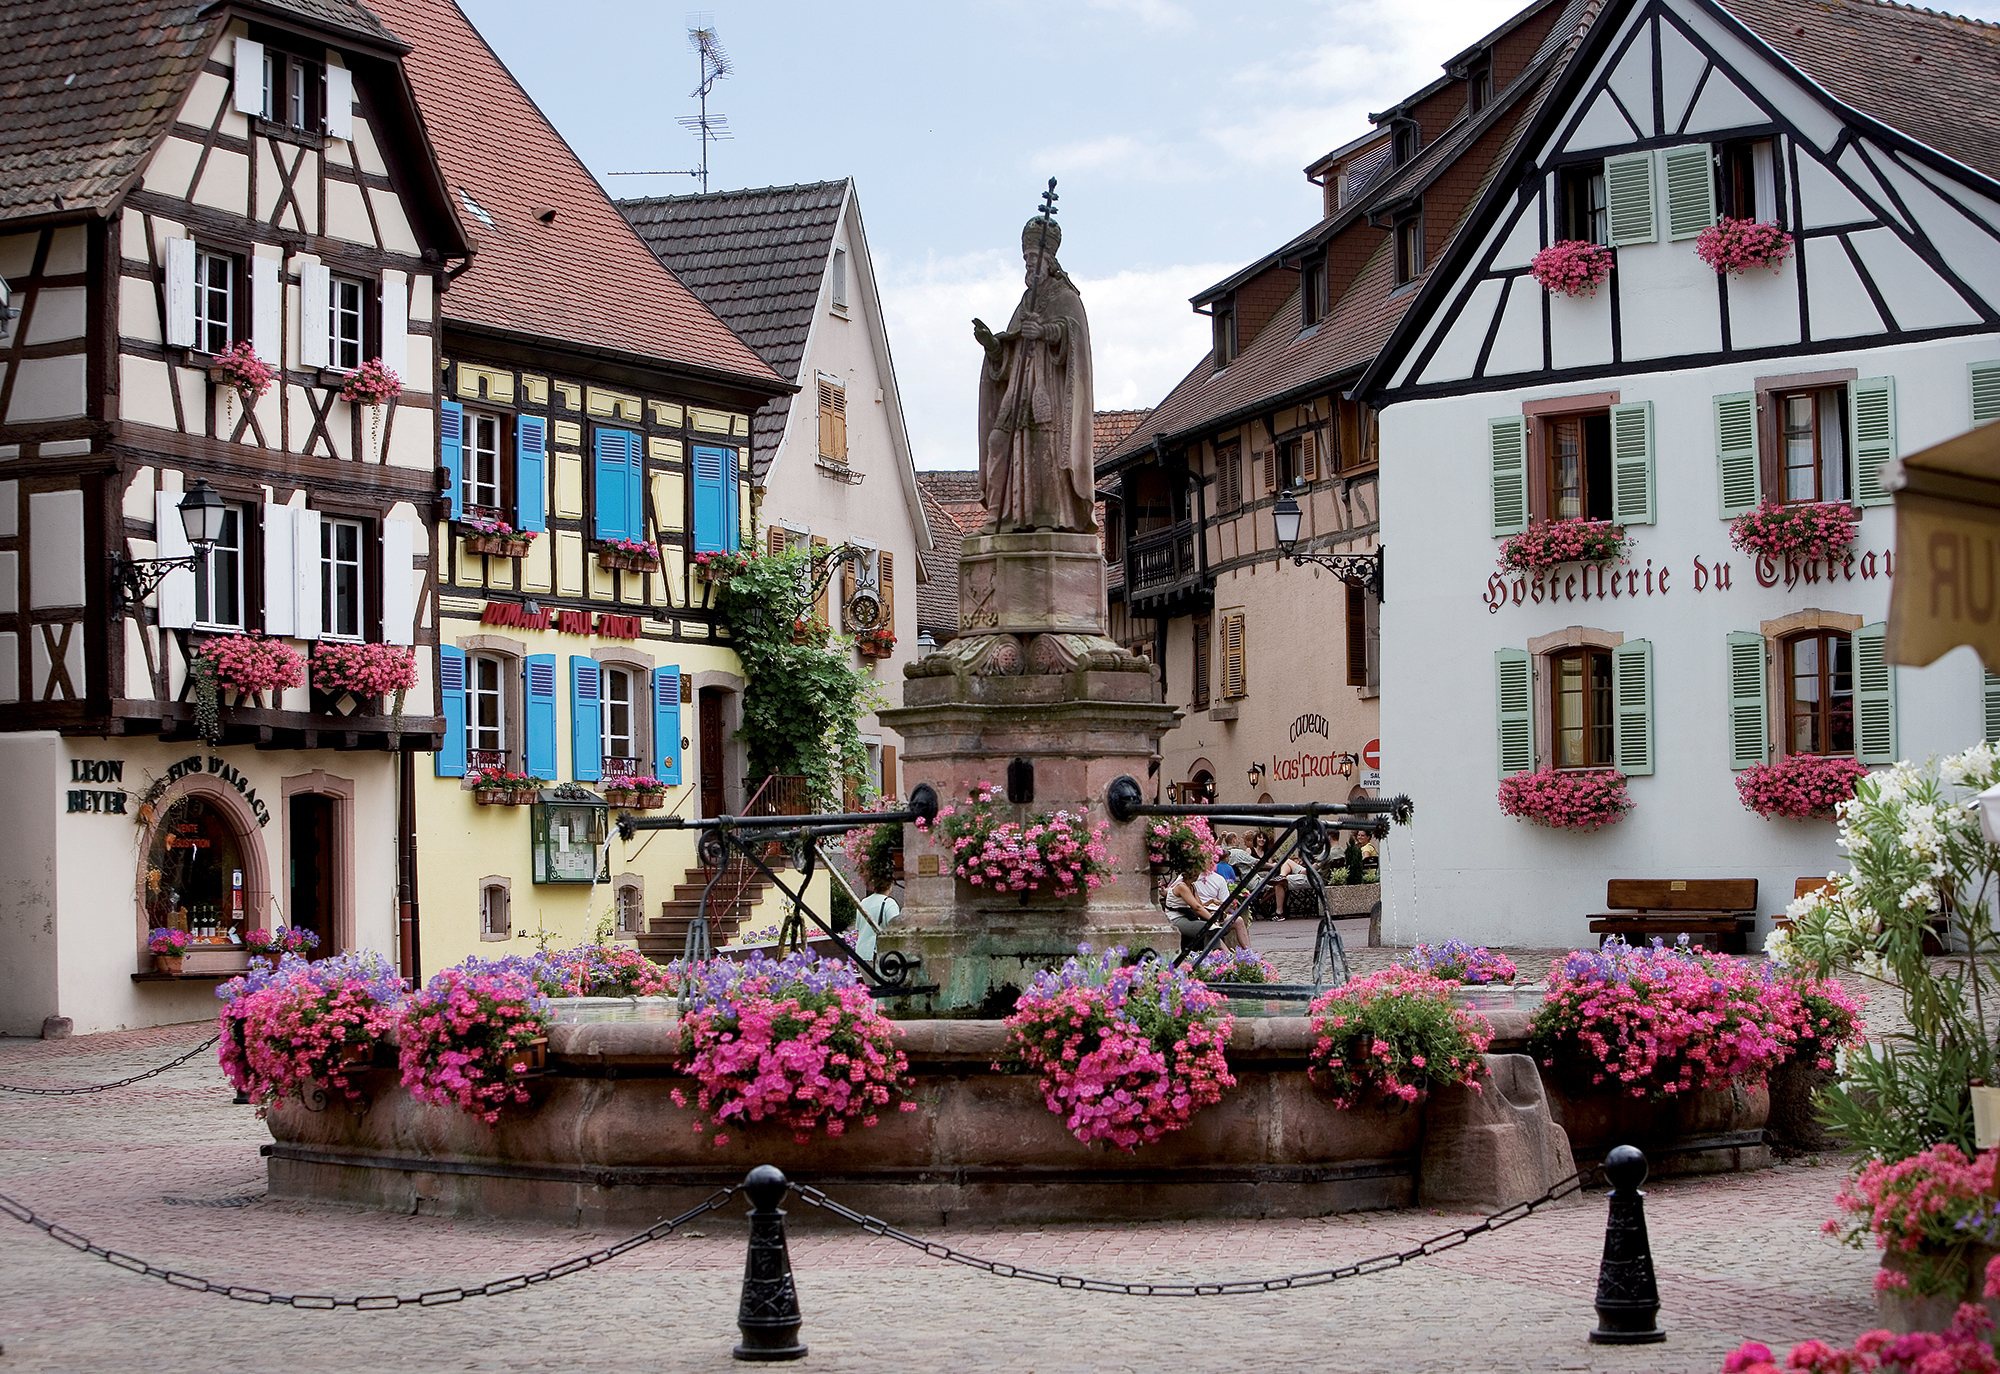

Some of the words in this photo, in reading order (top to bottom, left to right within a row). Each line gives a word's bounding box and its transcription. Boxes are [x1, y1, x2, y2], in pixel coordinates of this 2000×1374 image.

[1483, 559, 1671, 614] Hostellerie
[1693, 554, 1732, 591] du
[481, 602, 554, 630] DOMAINE
[559, 610, 596, 635] PAUL
[598, 614, 641, 640] ZINCK
[1290, 713, 1329, 743] caveau
[71, 759, 125, 783] LEON
[66, 789, 128, 815] BEYER
[208, 756, 270, 828] D'ALSACE
